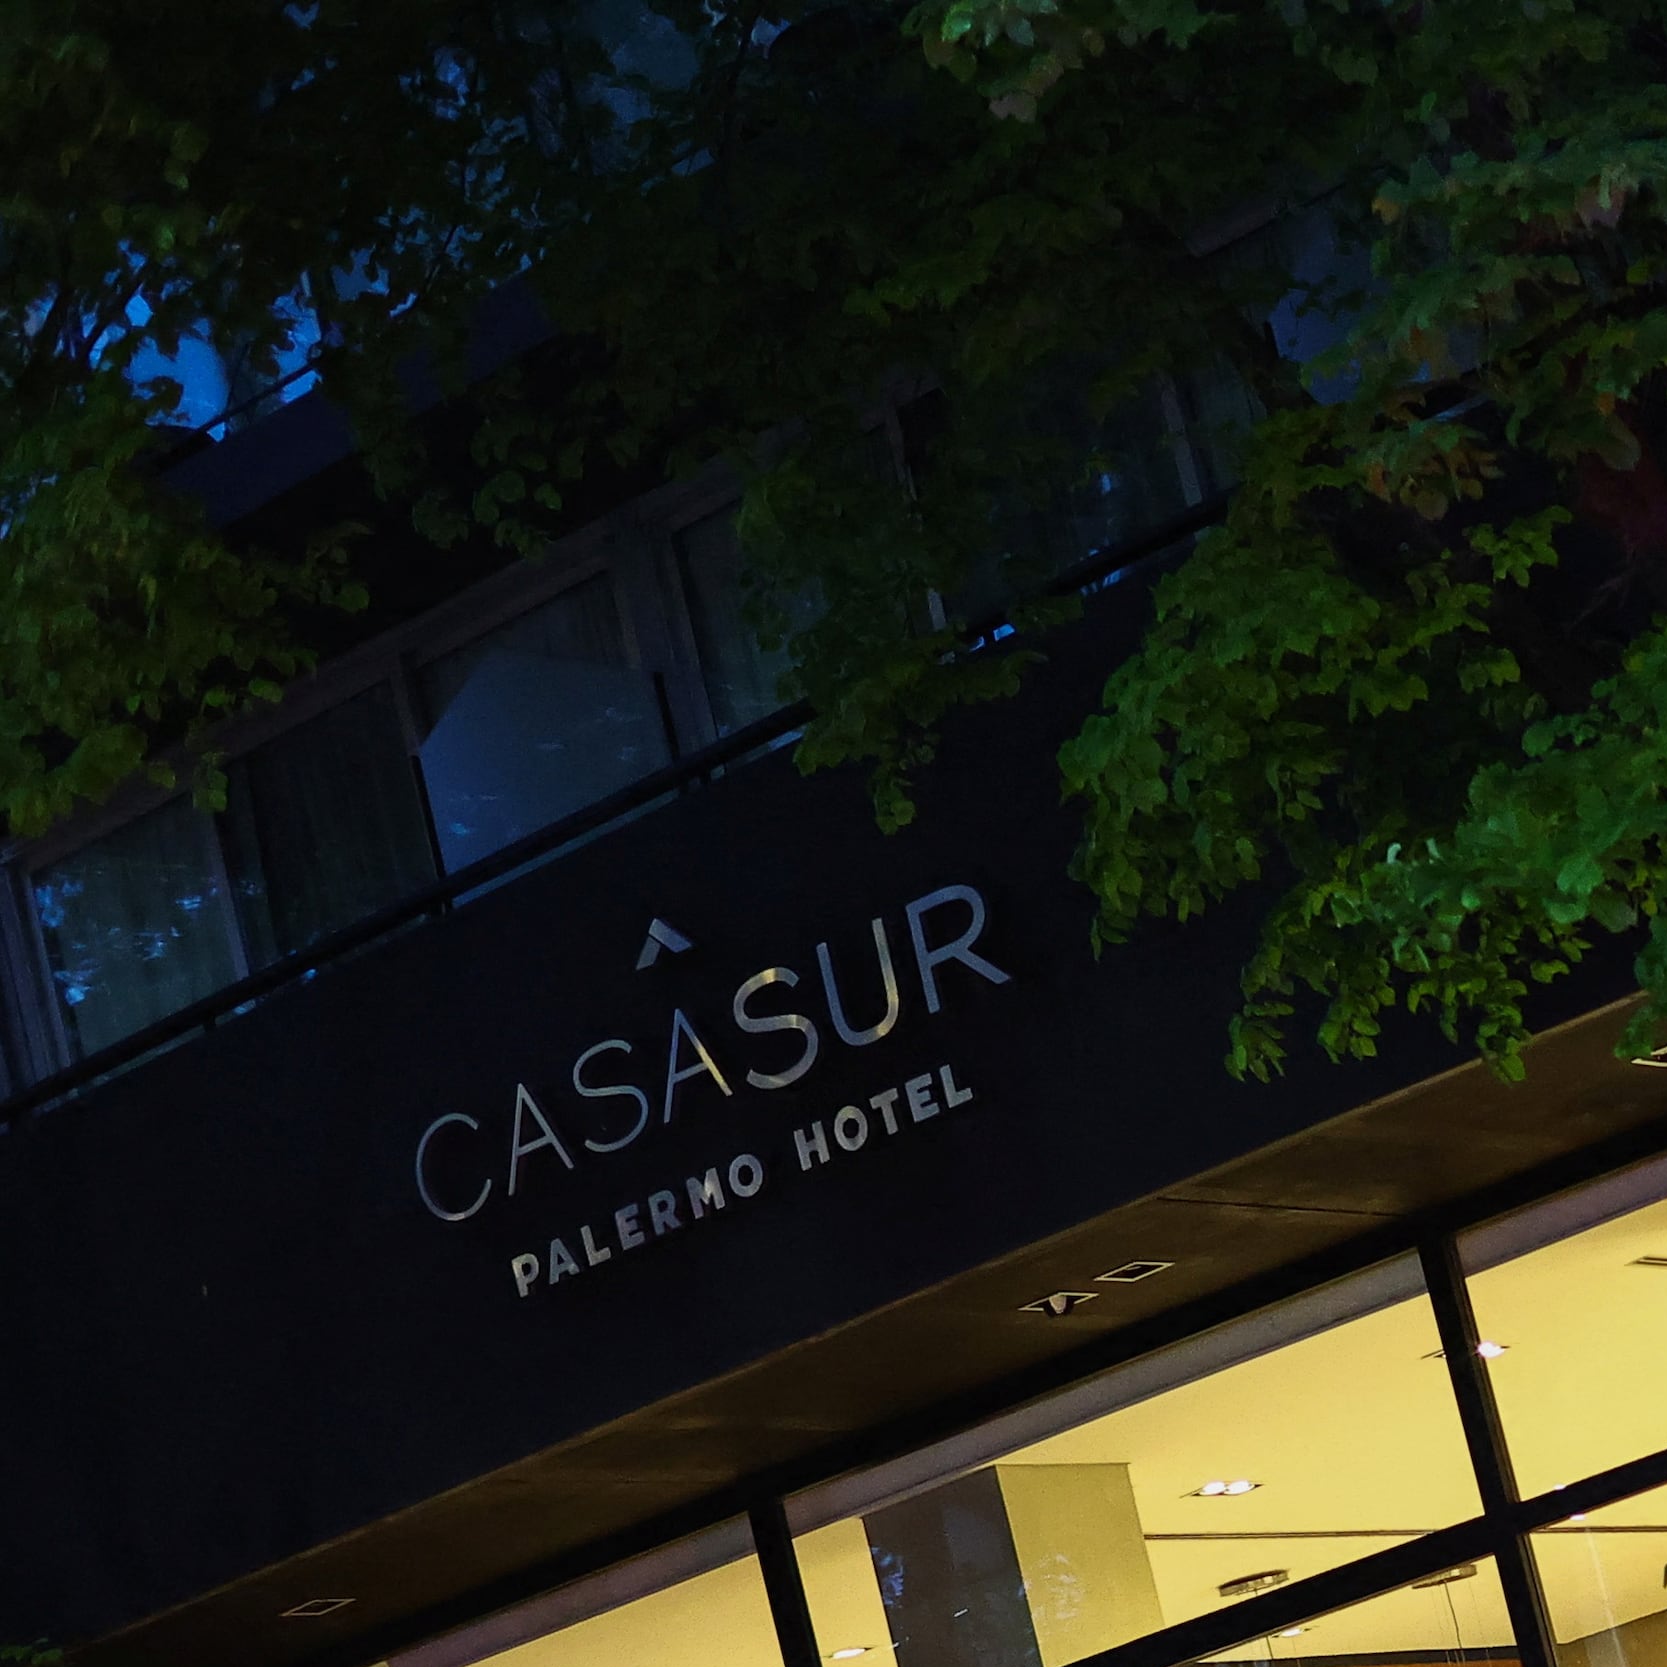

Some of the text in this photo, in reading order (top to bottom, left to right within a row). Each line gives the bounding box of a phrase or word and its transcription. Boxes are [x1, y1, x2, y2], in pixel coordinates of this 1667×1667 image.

[415, 884, 1012, 1221] CASASUR
[511, 1064, 973, 1297] PALERMO HOTEL
